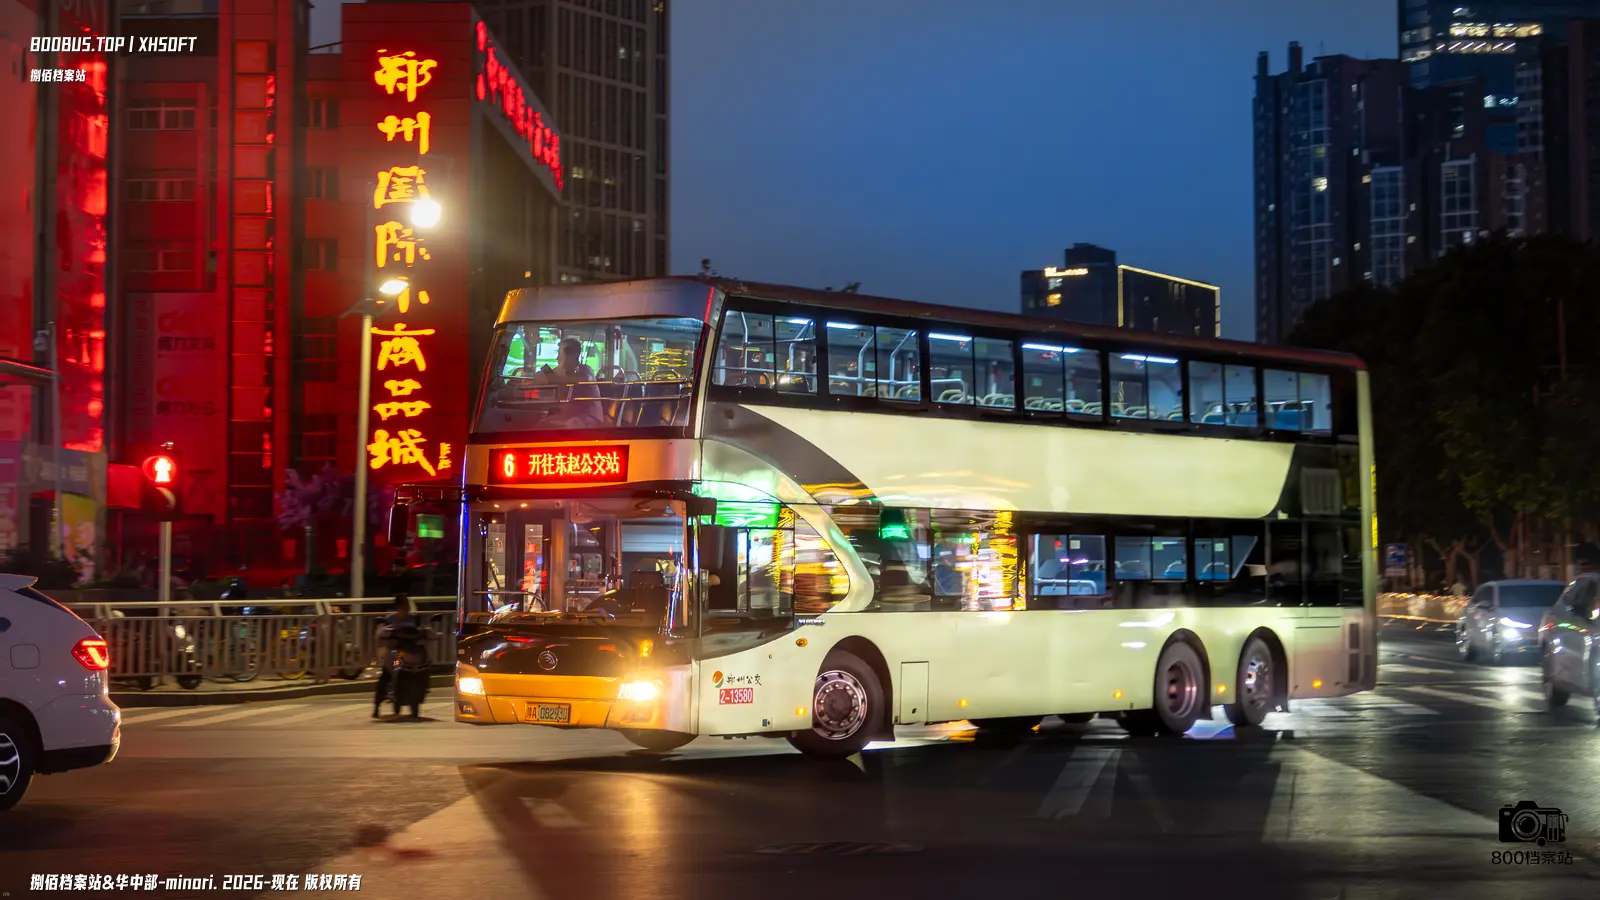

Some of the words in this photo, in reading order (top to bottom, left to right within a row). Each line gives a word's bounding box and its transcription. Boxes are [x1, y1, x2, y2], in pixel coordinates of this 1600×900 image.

[504, 453, 515, 477] 6
[528, 451, 620, 476] 开往东赵公交站
[720, 688, 753, 704] 2-13580
